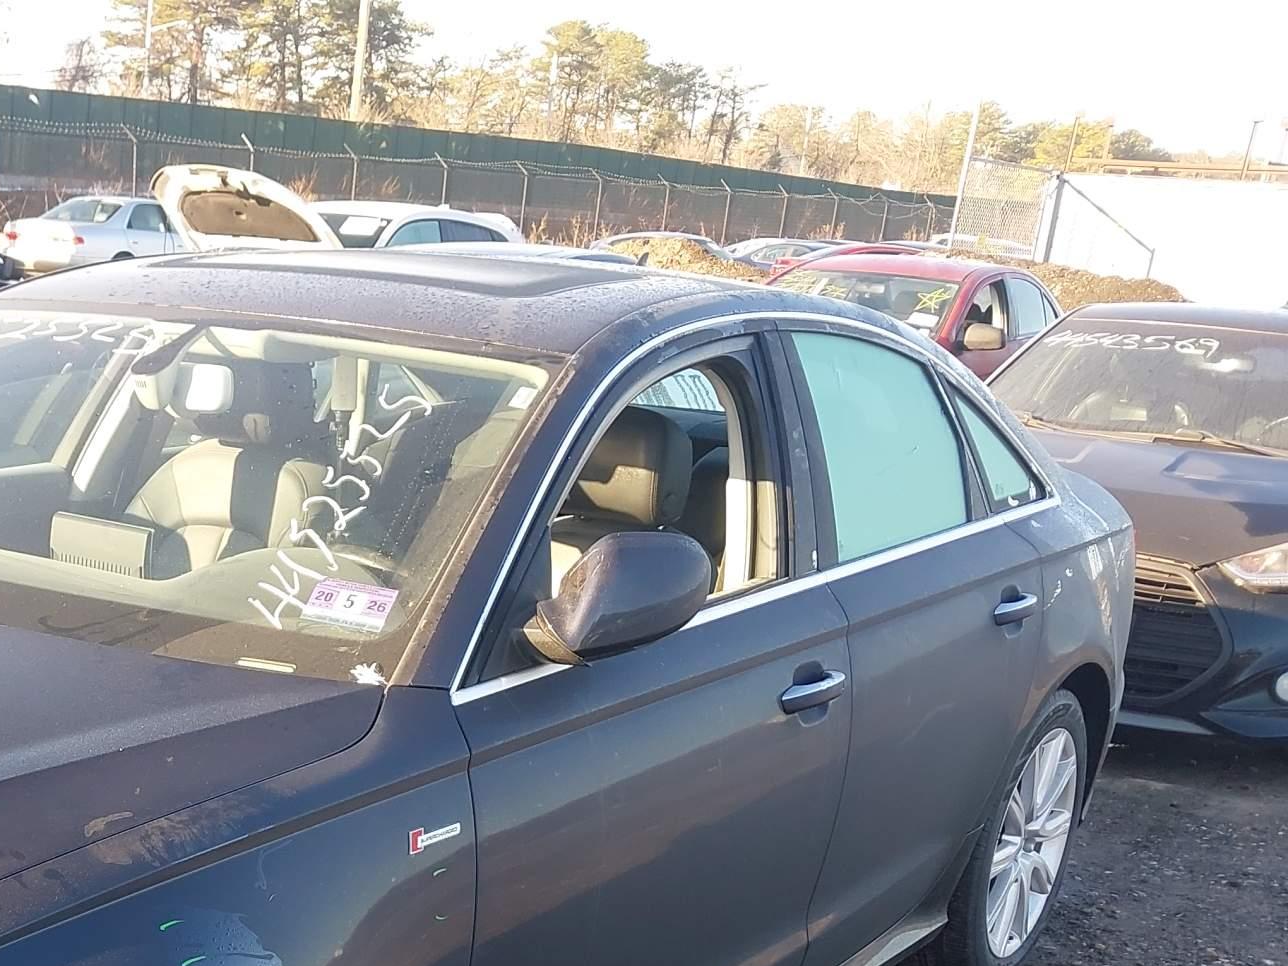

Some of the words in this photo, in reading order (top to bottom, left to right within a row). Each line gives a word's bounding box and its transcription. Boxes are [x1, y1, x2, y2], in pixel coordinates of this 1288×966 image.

[314, 590, 334, 602] 20
[343, 594, 358, 609] 5
[367, 600, 388, 613] 26
